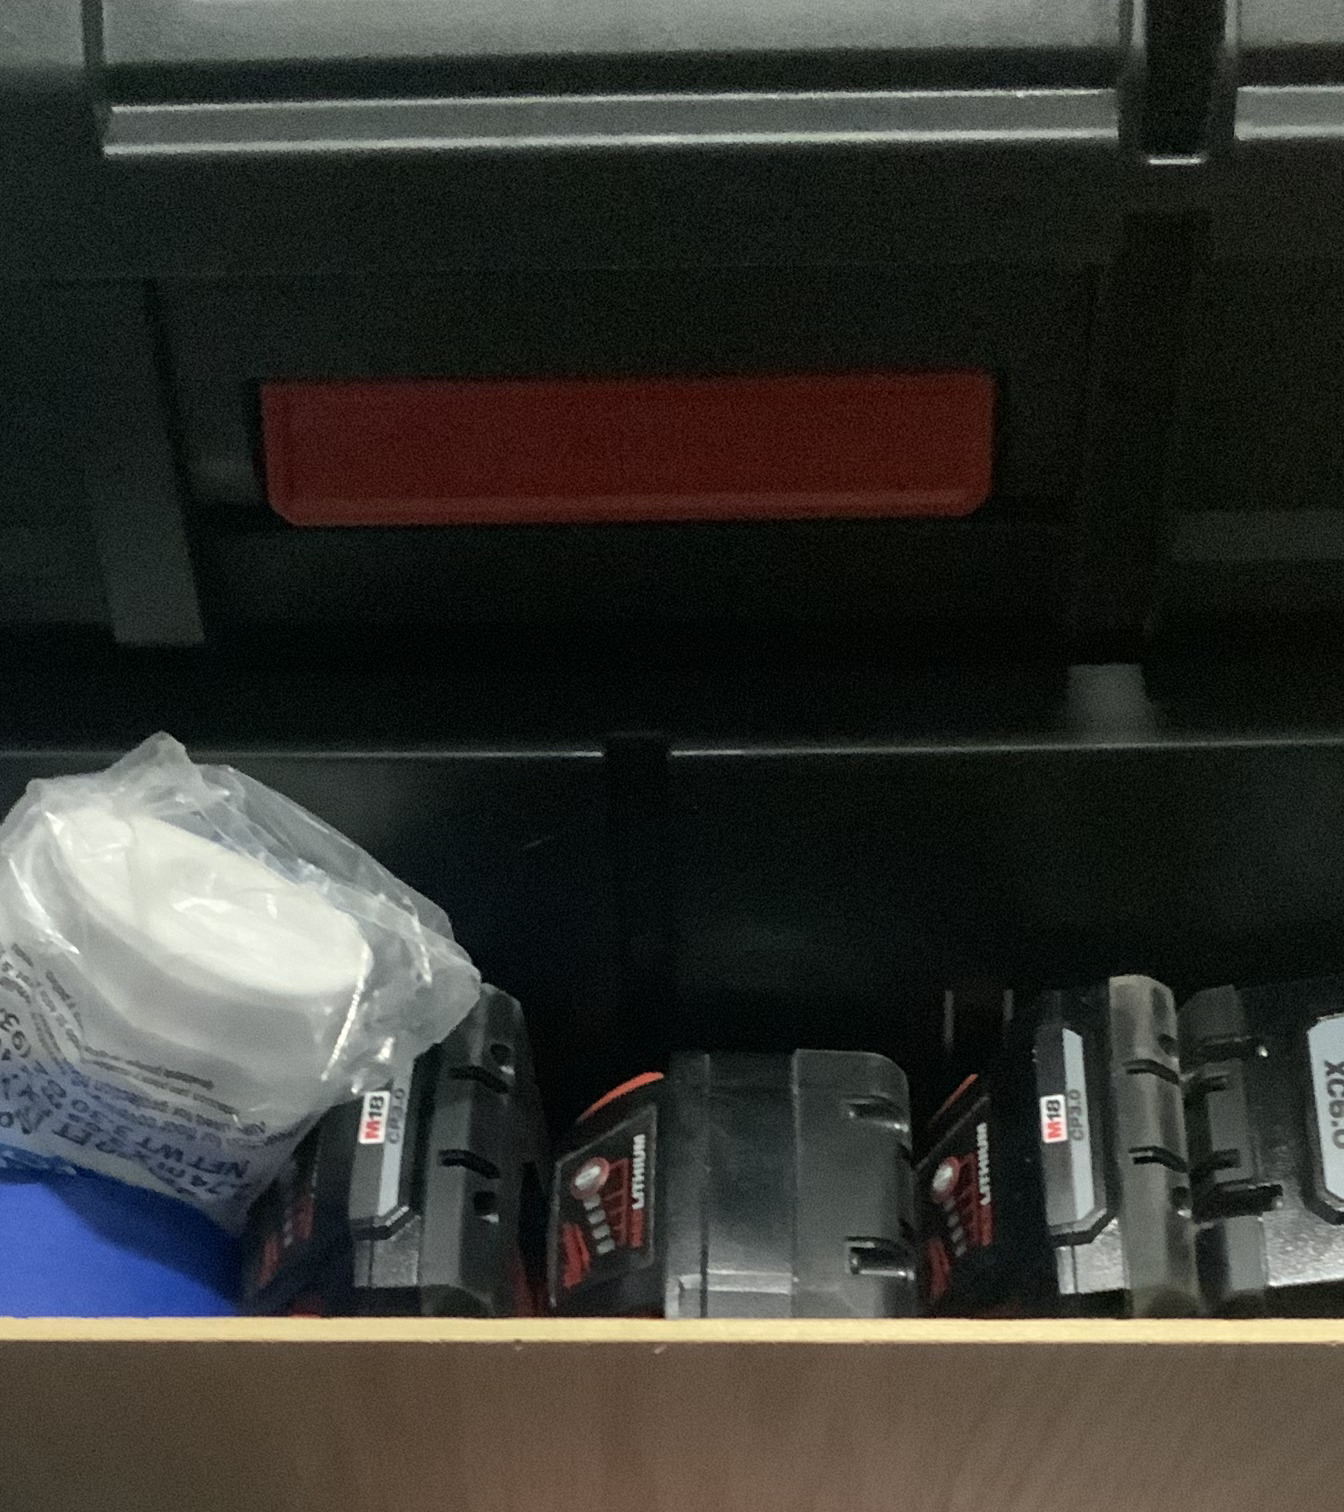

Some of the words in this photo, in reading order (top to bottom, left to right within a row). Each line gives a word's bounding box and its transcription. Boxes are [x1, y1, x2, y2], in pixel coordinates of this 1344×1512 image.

[364, 1095, 385, 1139] M18
[1045, 1099, 1062, 1139] M18
[631, 1134, 646, 1210] LITHIUM
